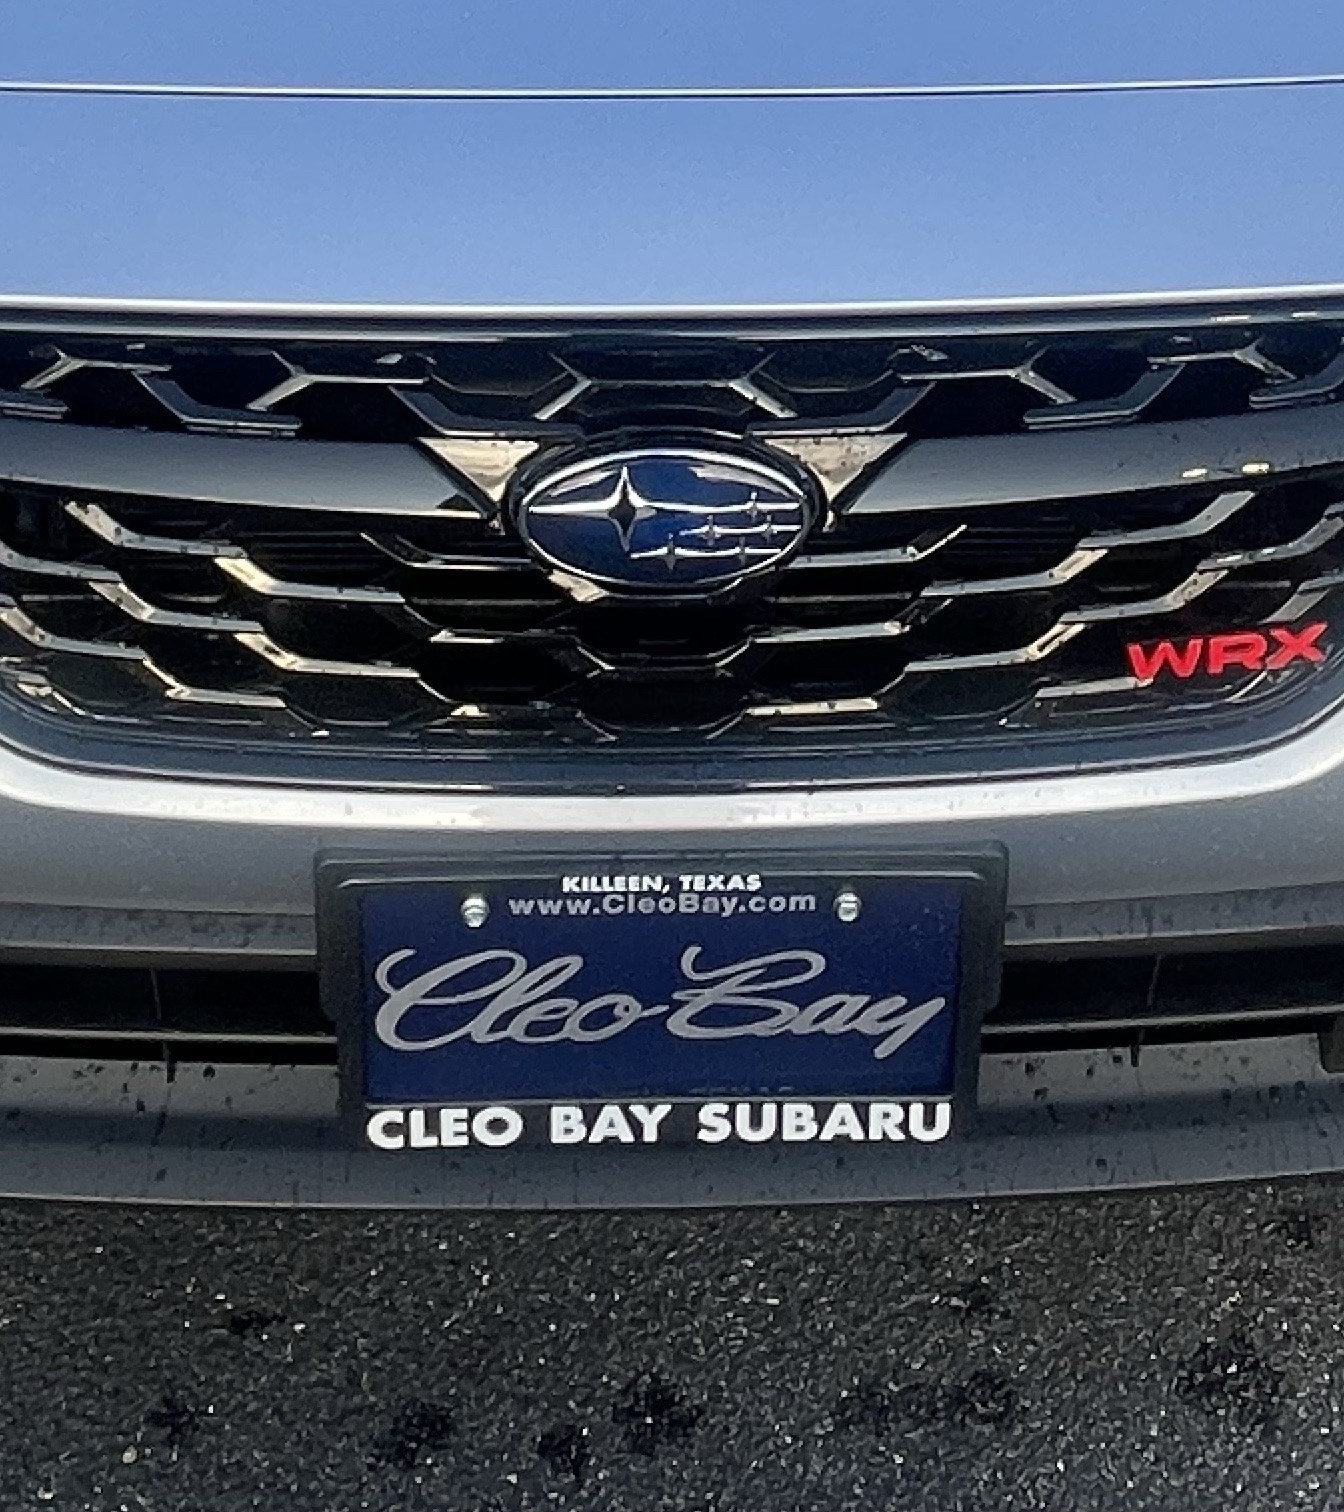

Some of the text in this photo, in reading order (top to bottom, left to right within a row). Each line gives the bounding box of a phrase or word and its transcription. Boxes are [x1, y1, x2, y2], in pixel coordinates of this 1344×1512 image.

[1127, 622, 1329, 680] WRX
[509, 893, 816, 917] www.CleoBay.com
[562, 874, 762, 893] KILLEEN, TEXAS
[375, 945, 946, 1059] Cleo Bay
[367, 1102, 952, 1149] CLEO BAY SUBARU
